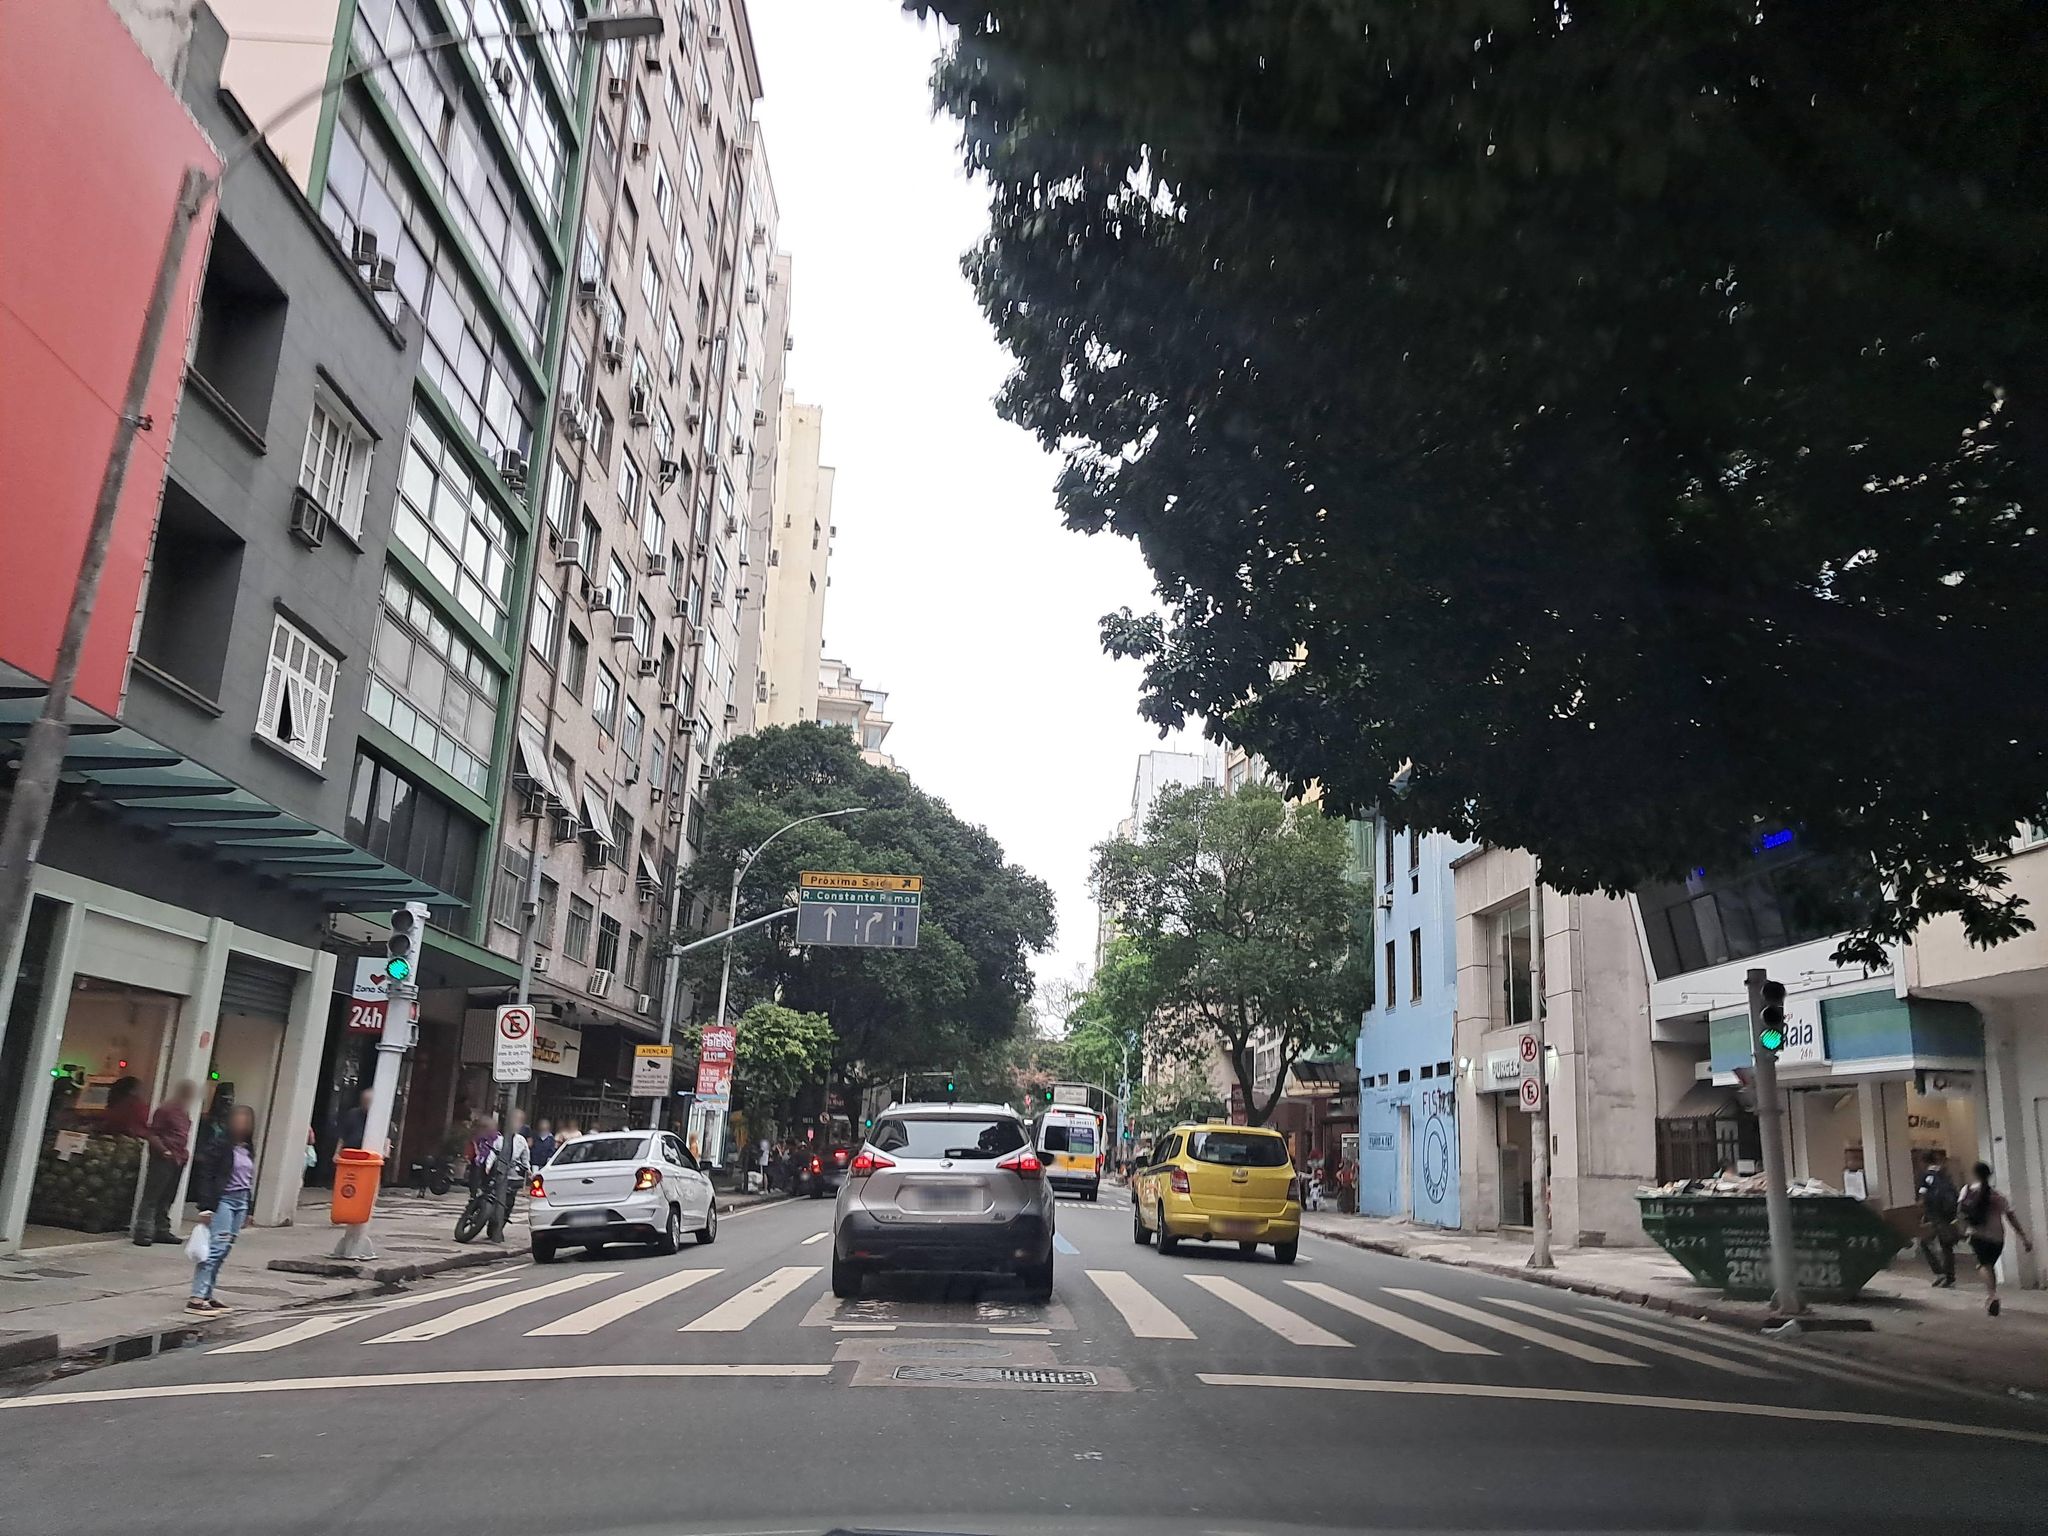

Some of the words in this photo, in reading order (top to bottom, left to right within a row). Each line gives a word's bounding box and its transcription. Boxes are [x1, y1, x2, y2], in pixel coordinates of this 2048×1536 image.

[810, 876, 857, 886] Próxima
[802, 890, 813, 899] R.
[816, 891, 876, 902] Constante
[879, 893, 917, 904] Rmos
[355, 984, 376, 993] Zona
[377, 986, 388, 994] Su
[349, 1005, 383, 1029] 24h
[1783, 1018, 1813, 1047] Raia
[1800, 1047, 1814, 1060] 24h
